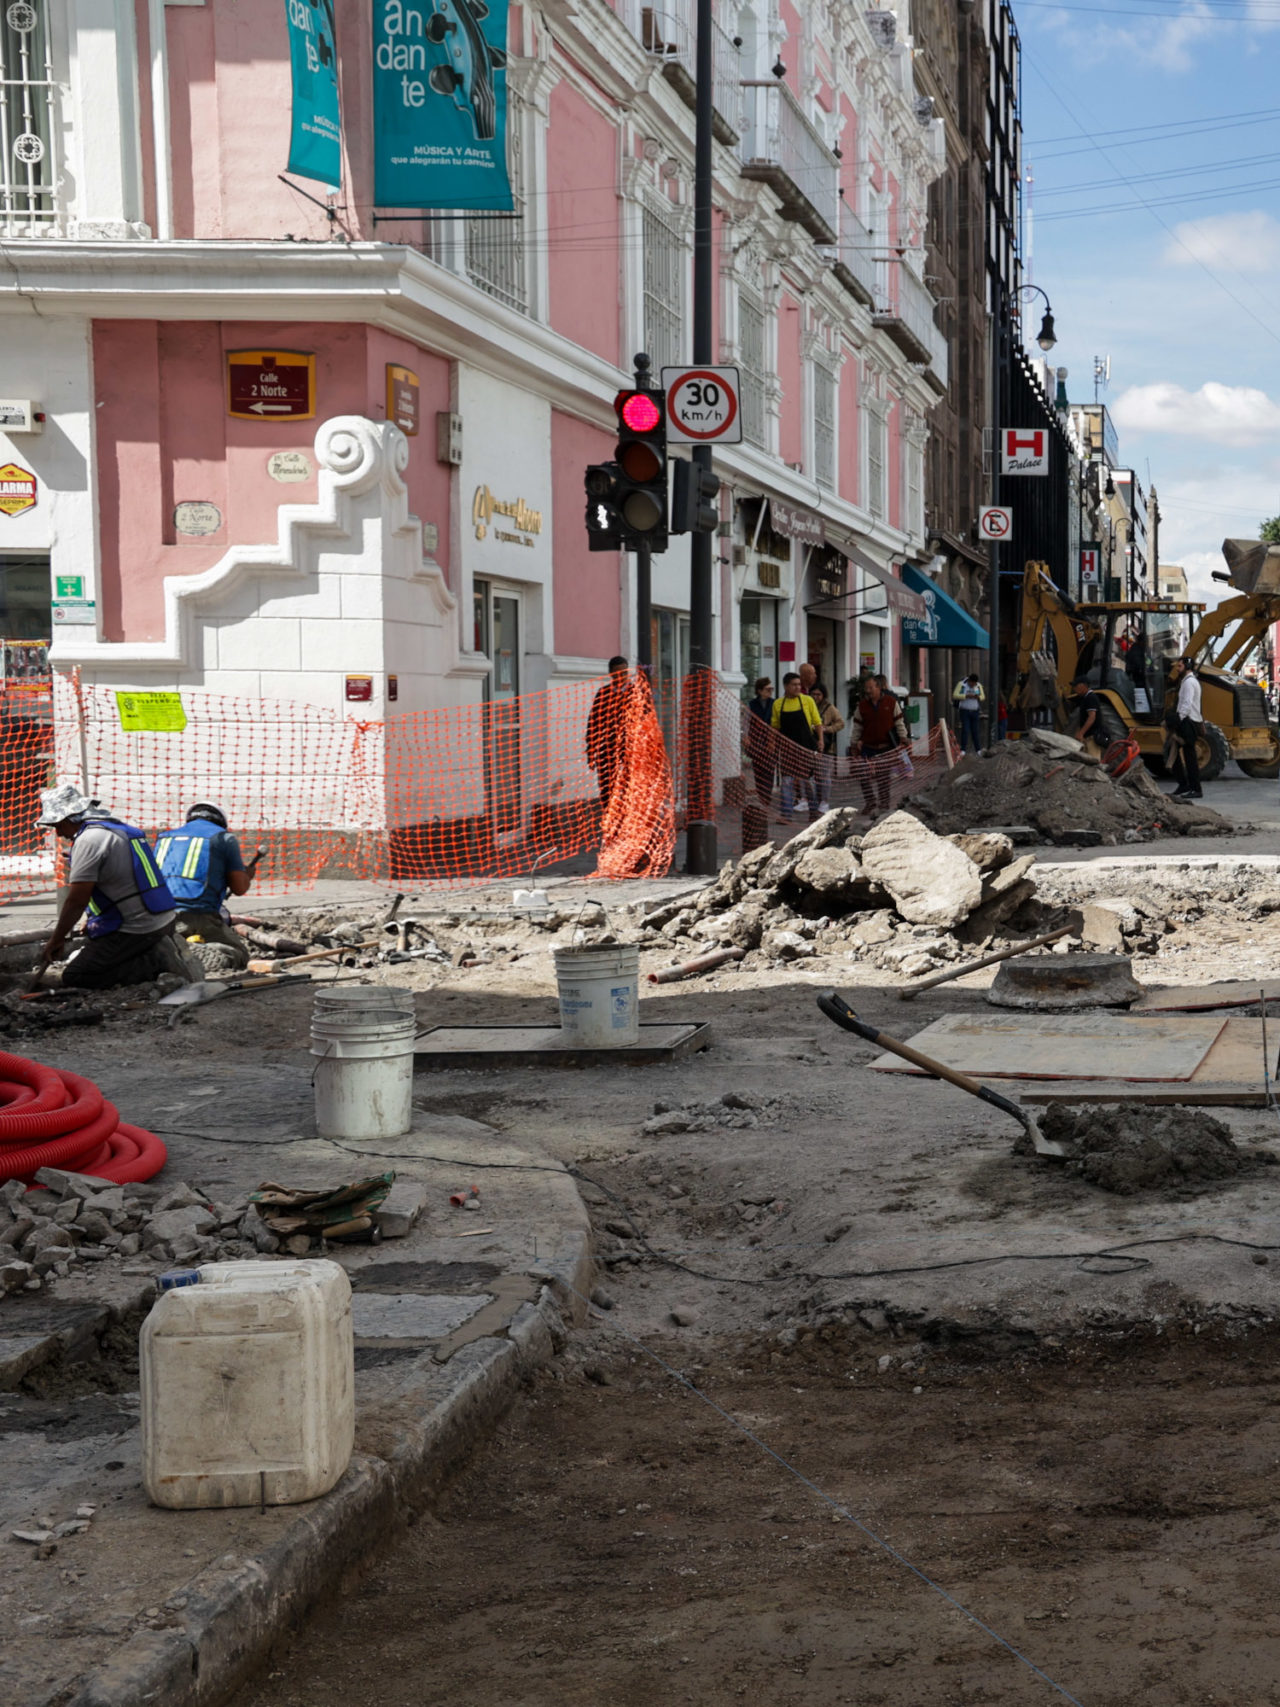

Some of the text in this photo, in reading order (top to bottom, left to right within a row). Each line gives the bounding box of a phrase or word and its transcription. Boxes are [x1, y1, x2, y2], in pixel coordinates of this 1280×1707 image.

[383, 0, 423, 37] an
[376, 35, 425, 71] dan
[400, 74, 425, 107] te
[413, 144, 491, 160] MÚSICA Y ARTE
[391, 156, 408, 165] que
[452, 157, 461, 165] tu
[463, 158, 496, 168] camino
[259, 373, 278, 383] Calle
[251, 385, 288, 397] 2 Norte
[686, 382, 719, 407] 30
[681, 409, 722, 421] km/h
[1007, 430, 1043, 457] H
[1008, 459, 1042, 471] Palace
[1081, 551, 1095, 572] H
